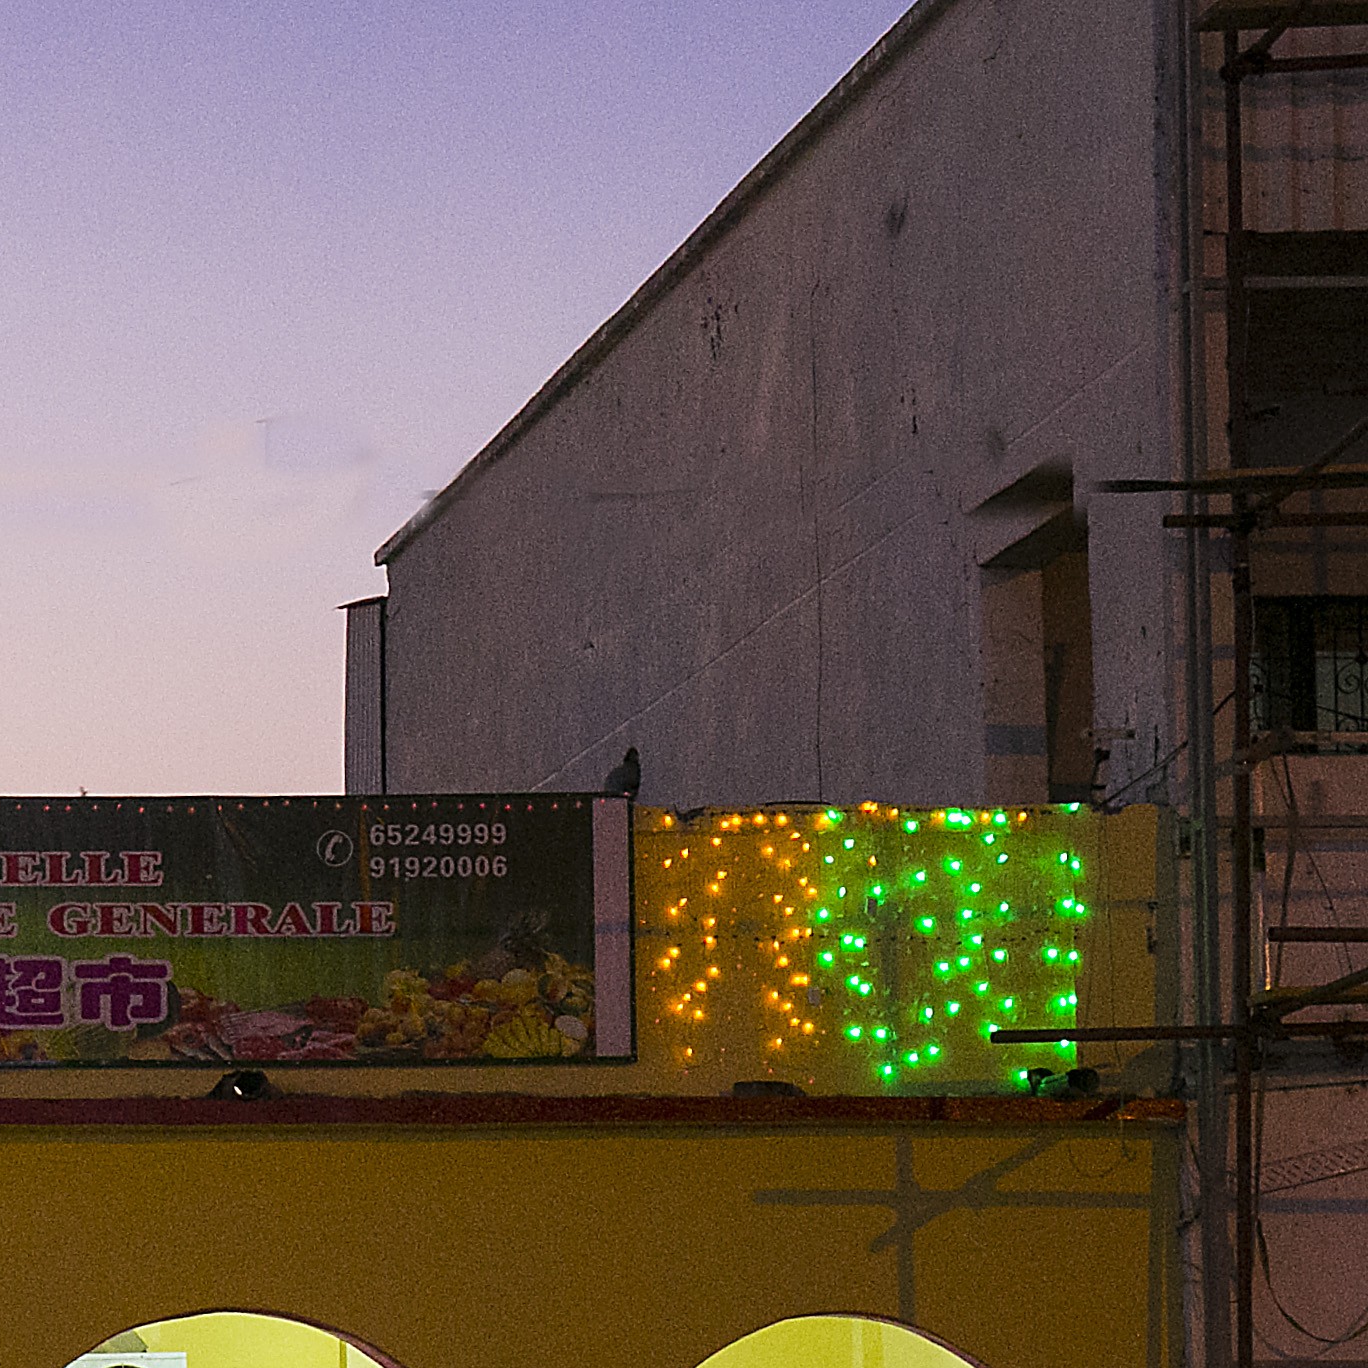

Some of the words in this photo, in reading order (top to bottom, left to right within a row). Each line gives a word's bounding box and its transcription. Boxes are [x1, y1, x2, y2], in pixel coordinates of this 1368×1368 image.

[369, 822, 508, 847] 65249999
[369, 855, 508, 879] 91920006
[46, 901, 398, 939] GENERALE
